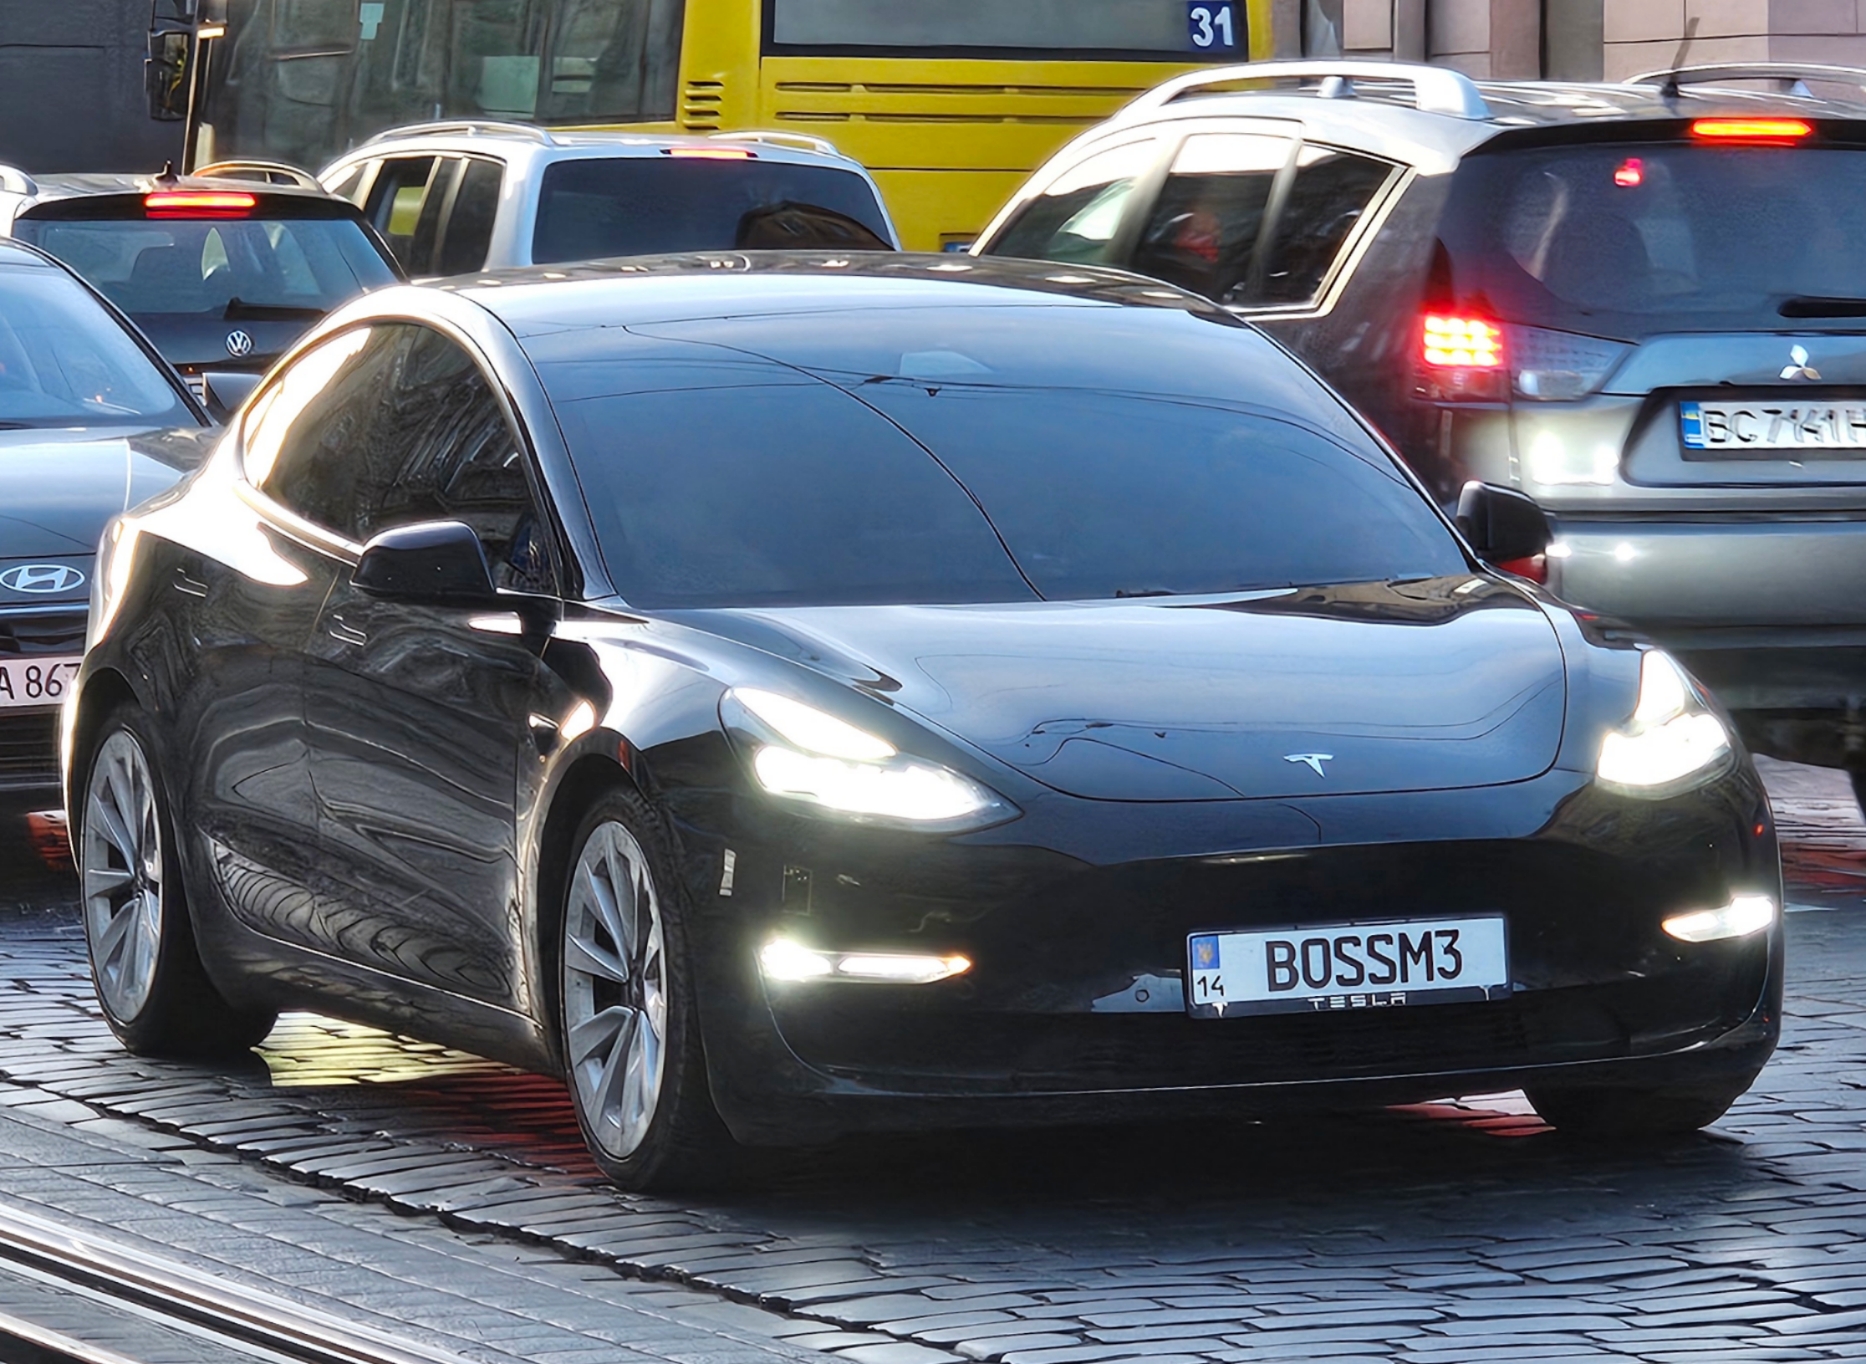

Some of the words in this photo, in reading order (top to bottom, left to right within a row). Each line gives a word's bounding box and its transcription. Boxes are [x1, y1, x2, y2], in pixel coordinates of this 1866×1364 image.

[1190, 6, 1234, 47] 31
[1265, 929, 1463, 992] BOSSM3
[1197, 975, 1225, 997] 14
[1307, 992, 1406, 1011] TESLA
